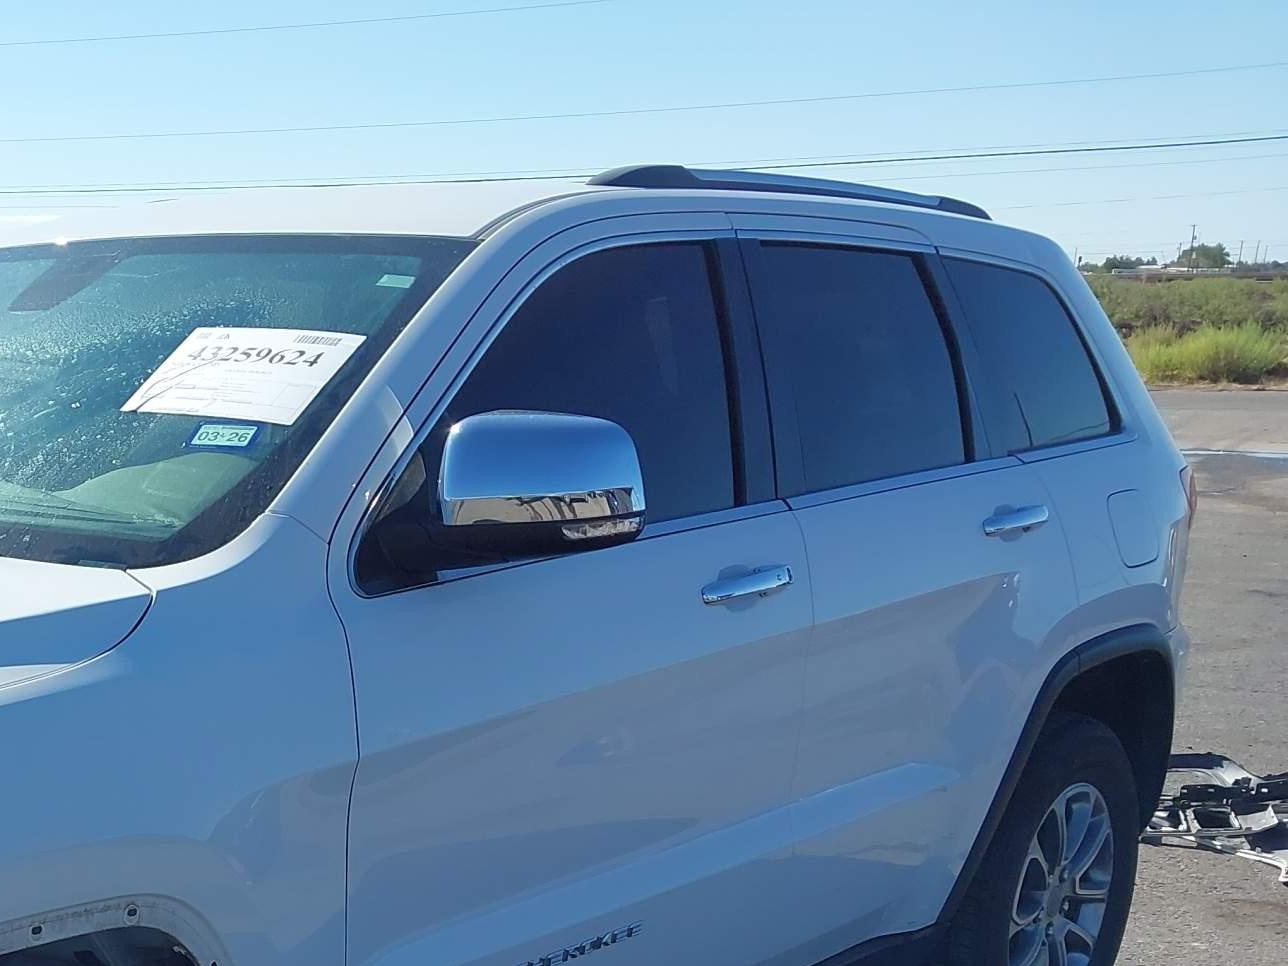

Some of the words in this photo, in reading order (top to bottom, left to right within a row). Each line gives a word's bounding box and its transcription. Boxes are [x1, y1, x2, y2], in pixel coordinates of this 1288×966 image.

[188, 345, 325, 367] 43259624
[197, 431, 220, 441] 03
[225, 431, 250, 442] 26
